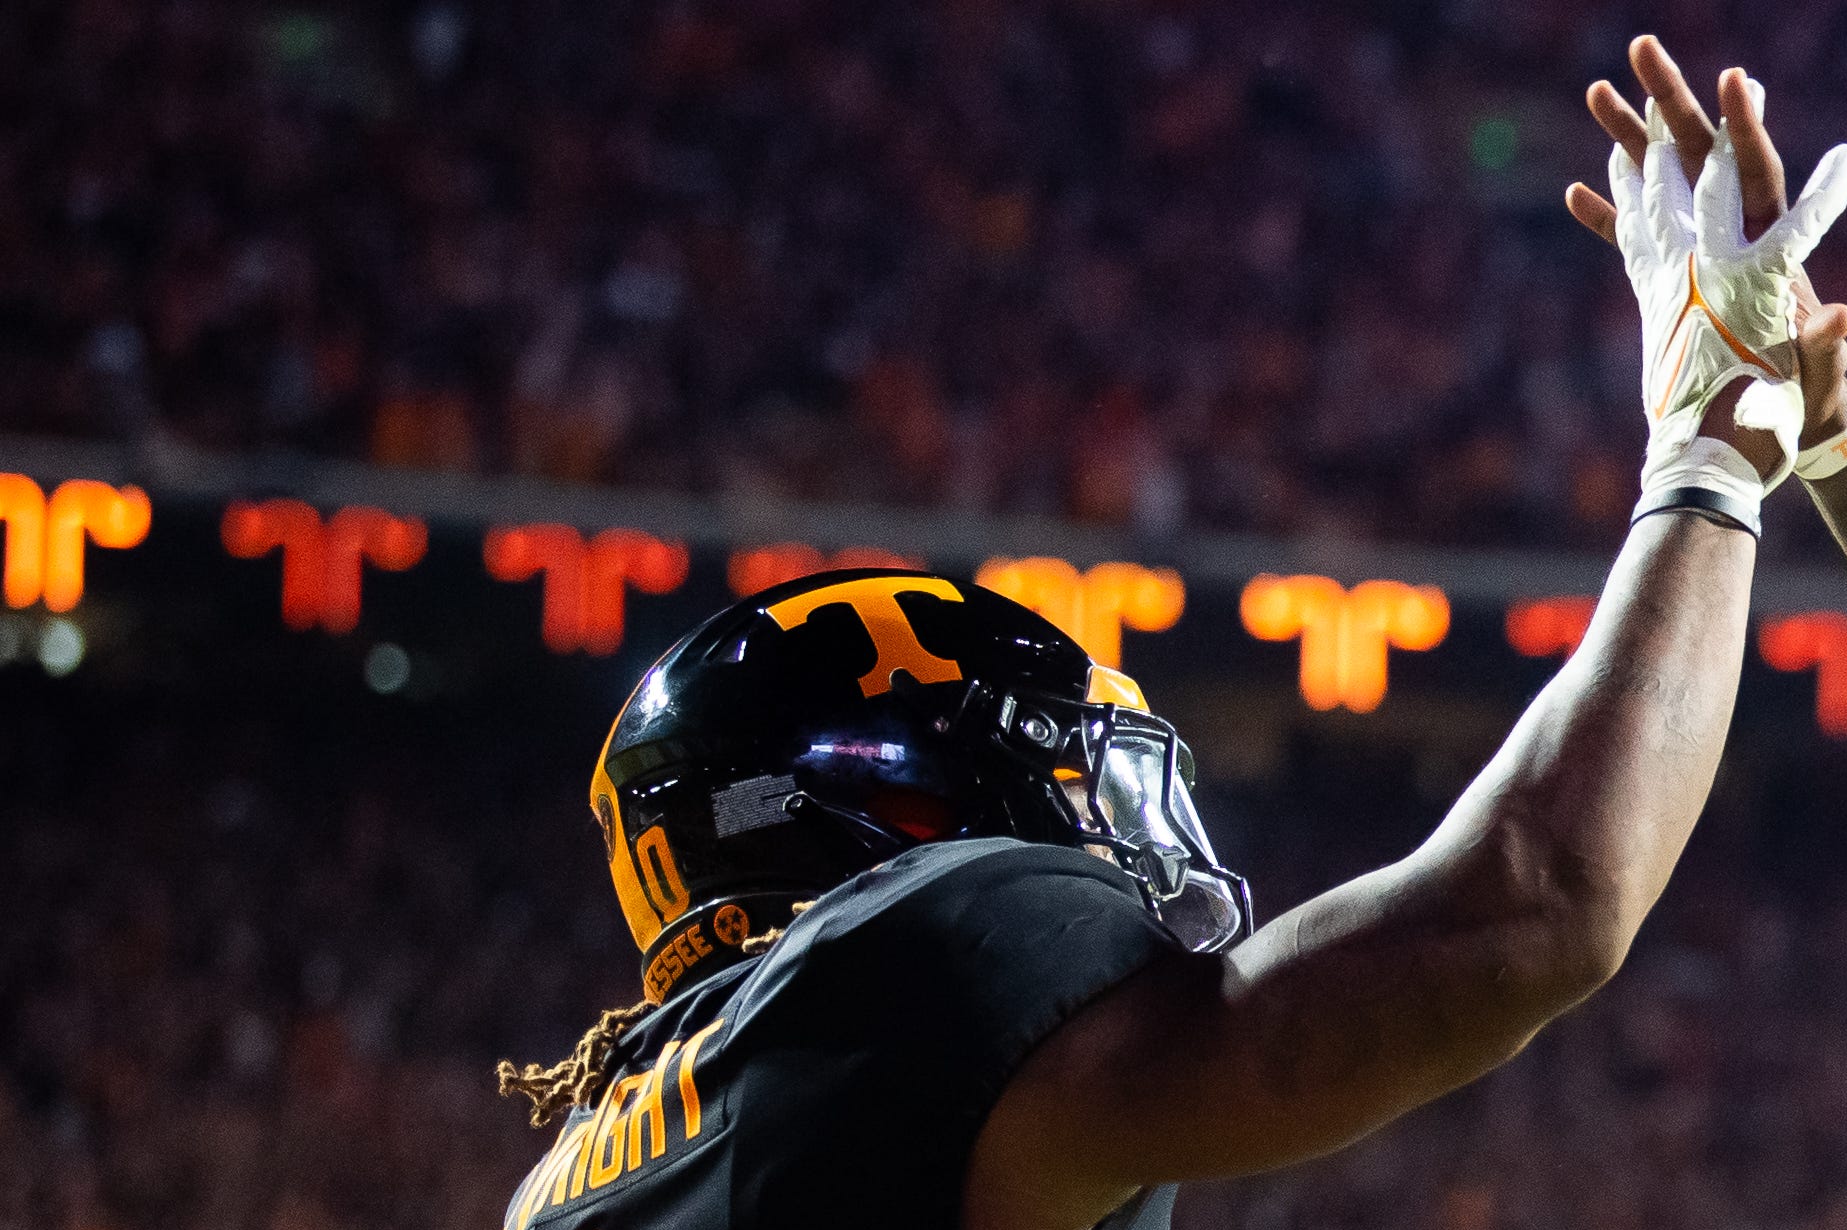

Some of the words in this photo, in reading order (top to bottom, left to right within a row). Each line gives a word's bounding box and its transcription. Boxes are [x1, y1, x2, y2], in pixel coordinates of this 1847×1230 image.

[766, 576, 965, 699] T
[637, 826, 690, 923] 0
[644, 922, 713, 1006] ESSEE
